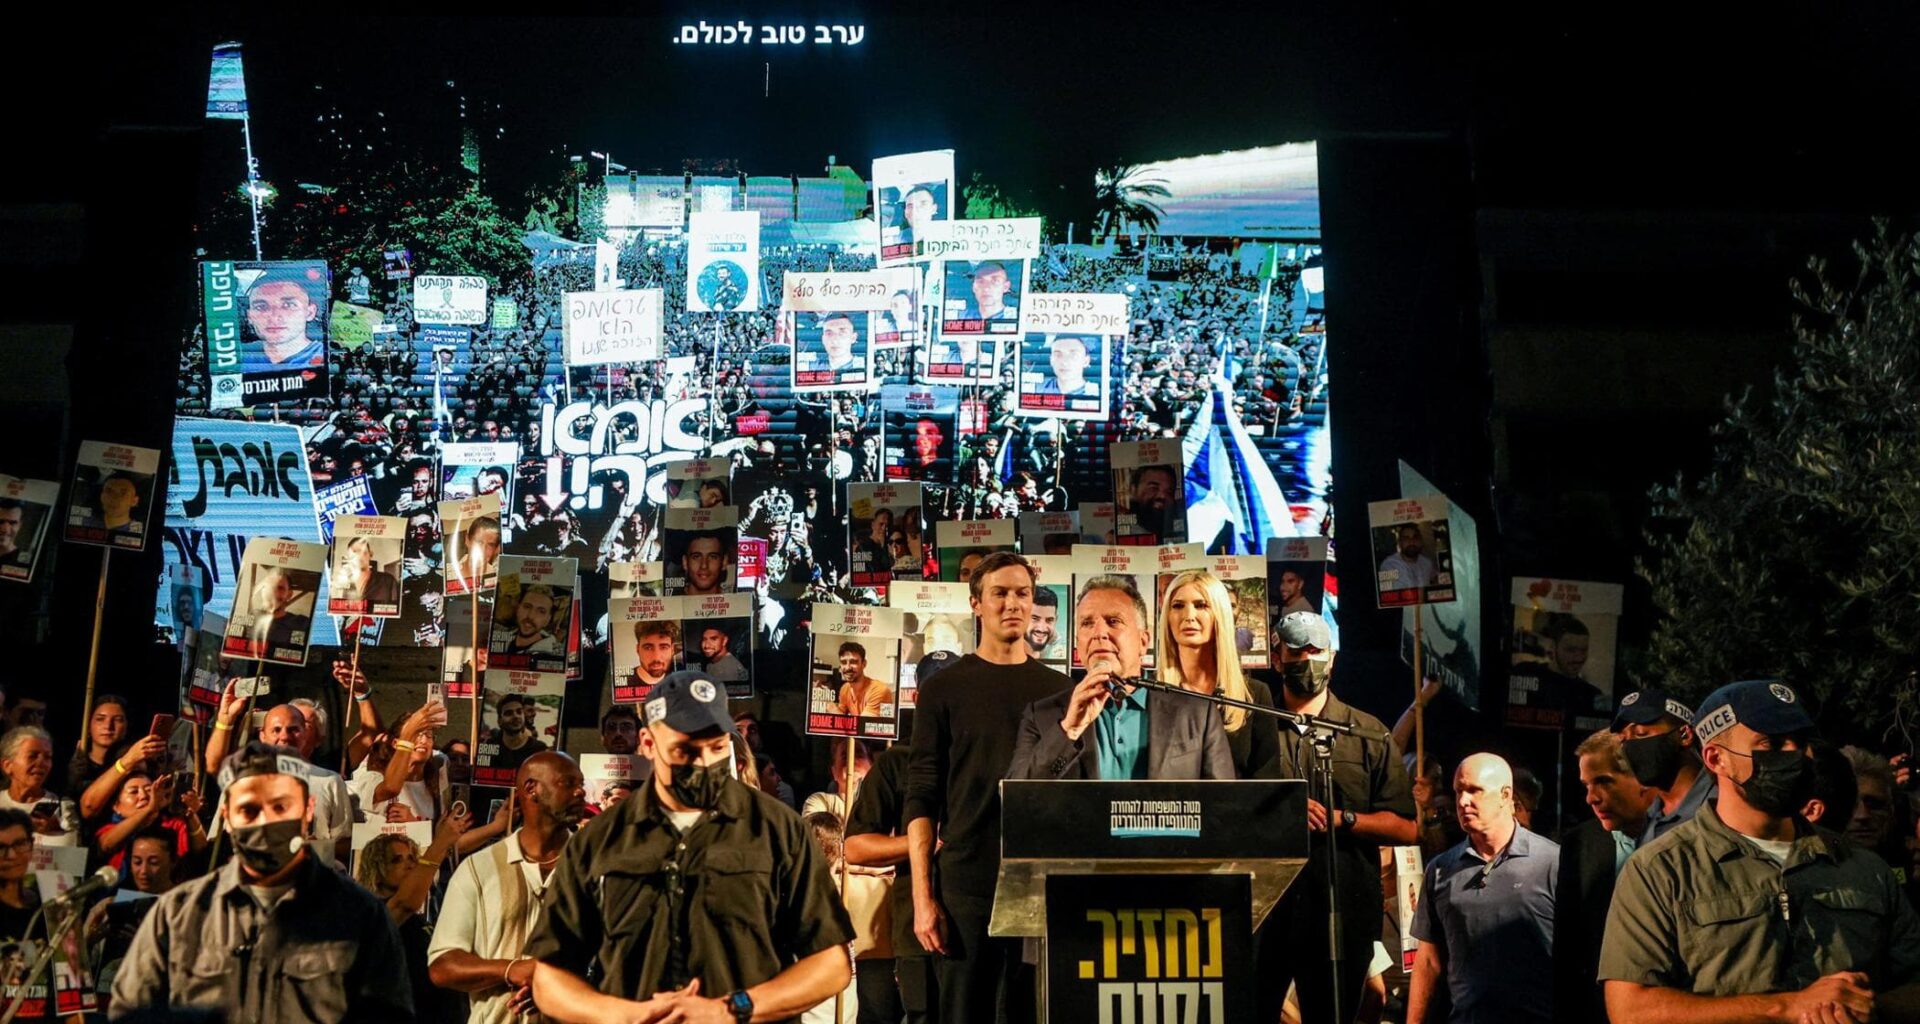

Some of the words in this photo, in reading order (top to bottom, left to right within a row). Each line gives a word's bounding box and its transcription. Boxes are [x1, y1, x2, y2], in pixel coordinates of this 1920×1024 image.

[673, 21, 753, 44] לכולם.
[761, 25, 806, 44] טוב
[814, 25, 865, 45] ערב
[573, 296, 647, 321] טראמפ
[1077, 299, 1095, 310] זה
[600, 317, 633, 336] הוא
[1091, 315, 1120, 331] אתה
[214, 322, 238, 367] מכבי
[283, 375, 304, 393] מתן
[181, 435, 300, 519] אהבת
[852, 551, 873, 562] BRING
[853, 562, 866, 572] HIM
[665, 577, 686, 587] BRING
[614, 666, 634, 677] BRING
[614, 677, 628, 687] HIM
[1510, 675, 1540, 691] BRING
[614, 686, 634, 697] HOME
[811, 687, 836, 702] BRING
[1508, 691, 1528, 705] HIM
[810, 701, 827, 713] HIM
[810, 713, 833, 728] HOME
[834, 716, 857, 730] NOW!
[1700, 710, 1733, 740] OLICE
[479, 743, 500, 755] BRING
[477, 755, 491, 767] HIM
[1110, 799, 1141, 814] להחזרת
[1142, 800, 1182, 814] המשפחות
[1183, 801, 1202, 814] מטה
[1110, 814, 1157, 832] והנעדרים
[1159, 814, 1203, 831] החטופים
[1078, 907, 1224, 979] נחזיר.
